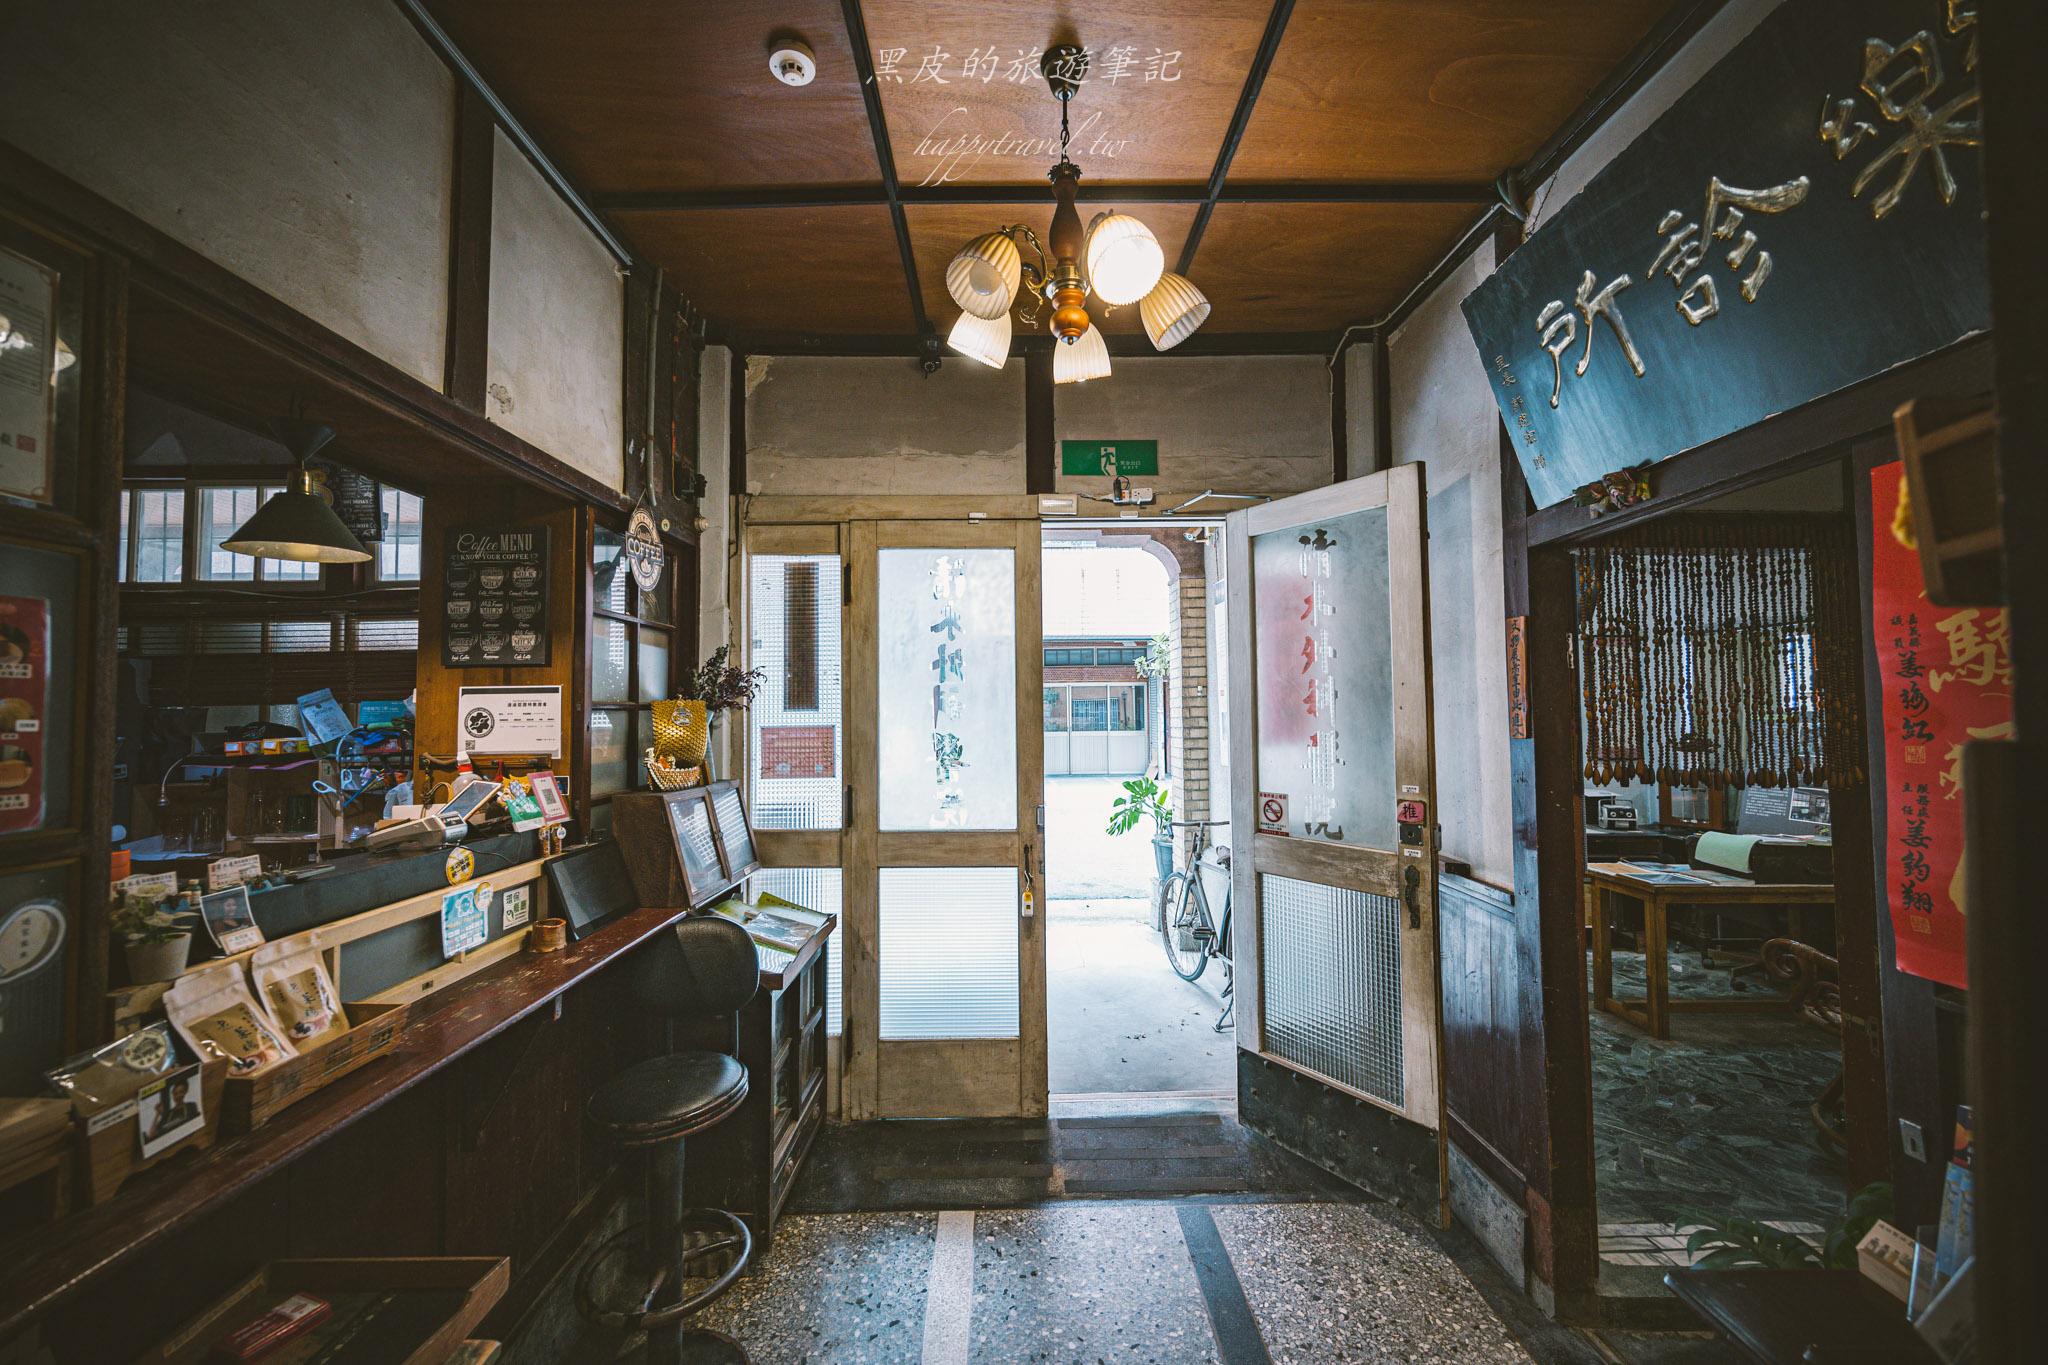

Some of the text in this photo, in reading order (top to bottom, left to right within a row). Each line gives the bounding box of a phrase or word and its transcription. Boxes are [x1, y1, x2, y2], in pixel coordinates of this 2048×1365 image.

[457, 533, 533, 557] Coffee MENU
[627, 537, 663, 563] COFFEE
[460, 552, 529, 561] KNOW YOUR COFFEE
[1403, 803, 1418, 819] 推
